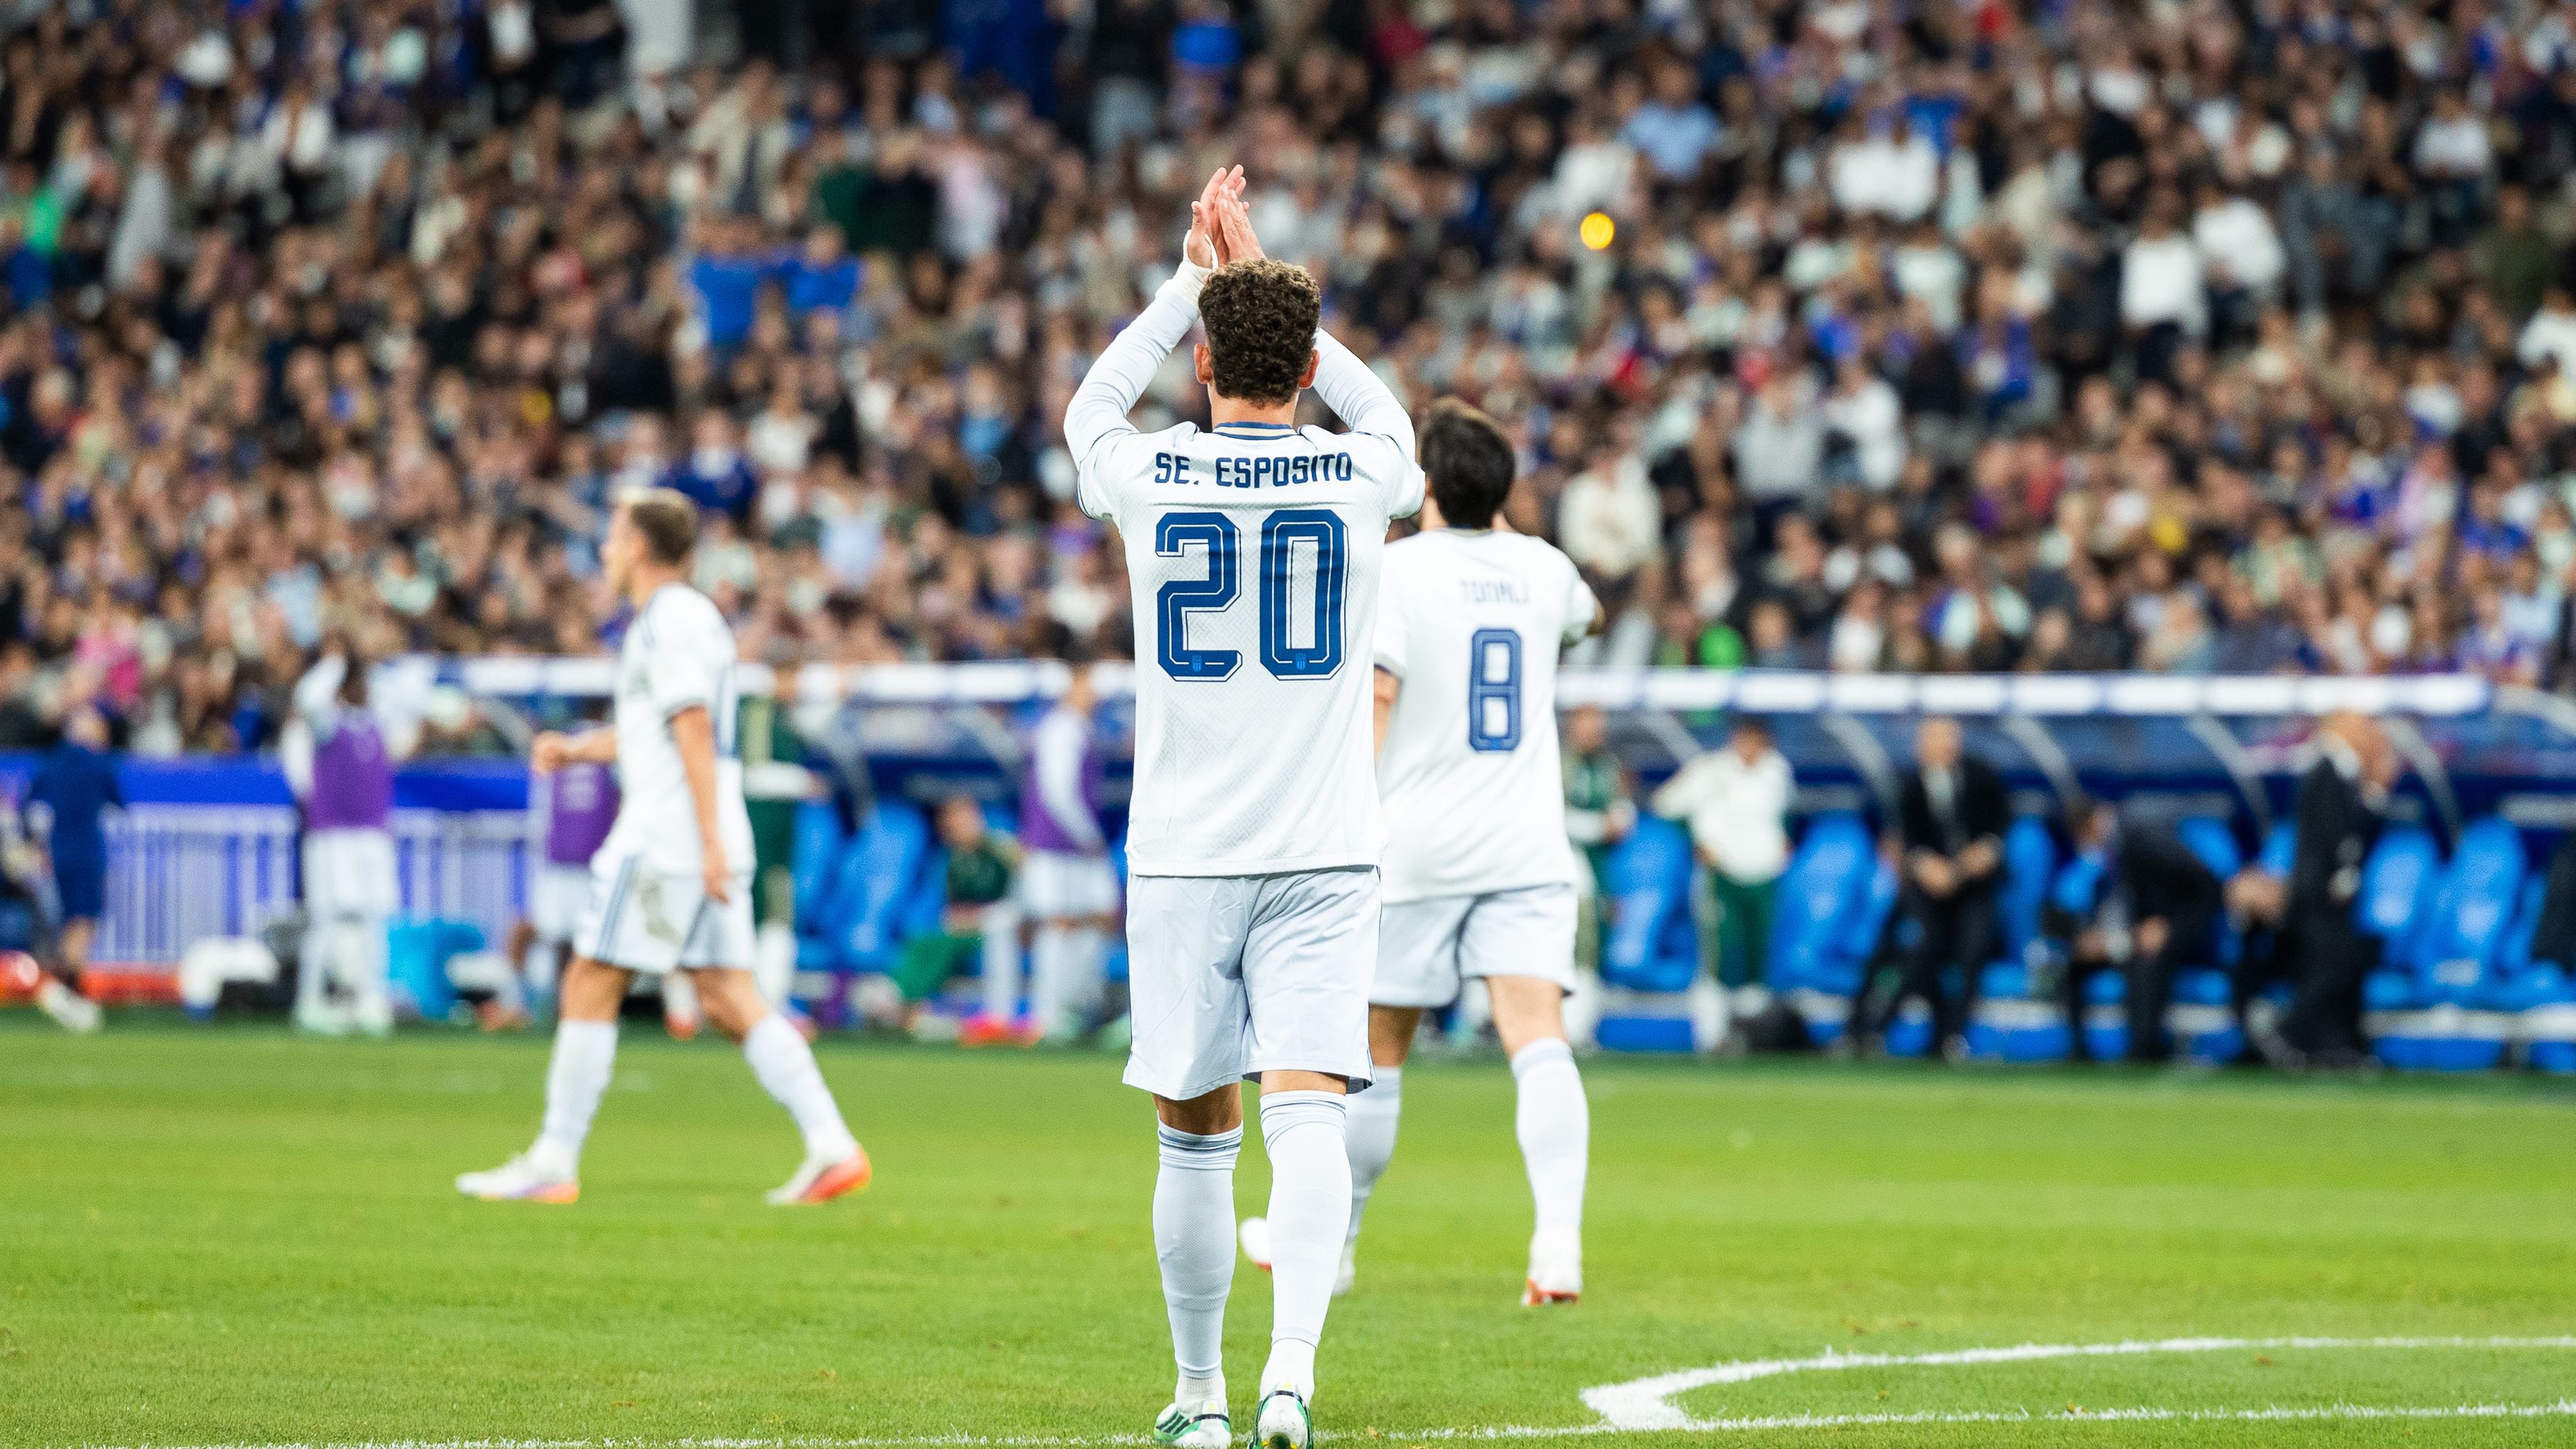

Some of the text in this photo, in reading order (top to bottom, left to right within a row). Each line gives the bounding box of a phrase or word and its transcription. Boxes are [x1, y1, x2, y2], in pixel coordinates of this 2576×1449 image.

[1154, 452, 1352, 488] SE. ESPOSITO
[1155, 509, 1349, 682] 20
[1468, 628, 1523, 752] 8
